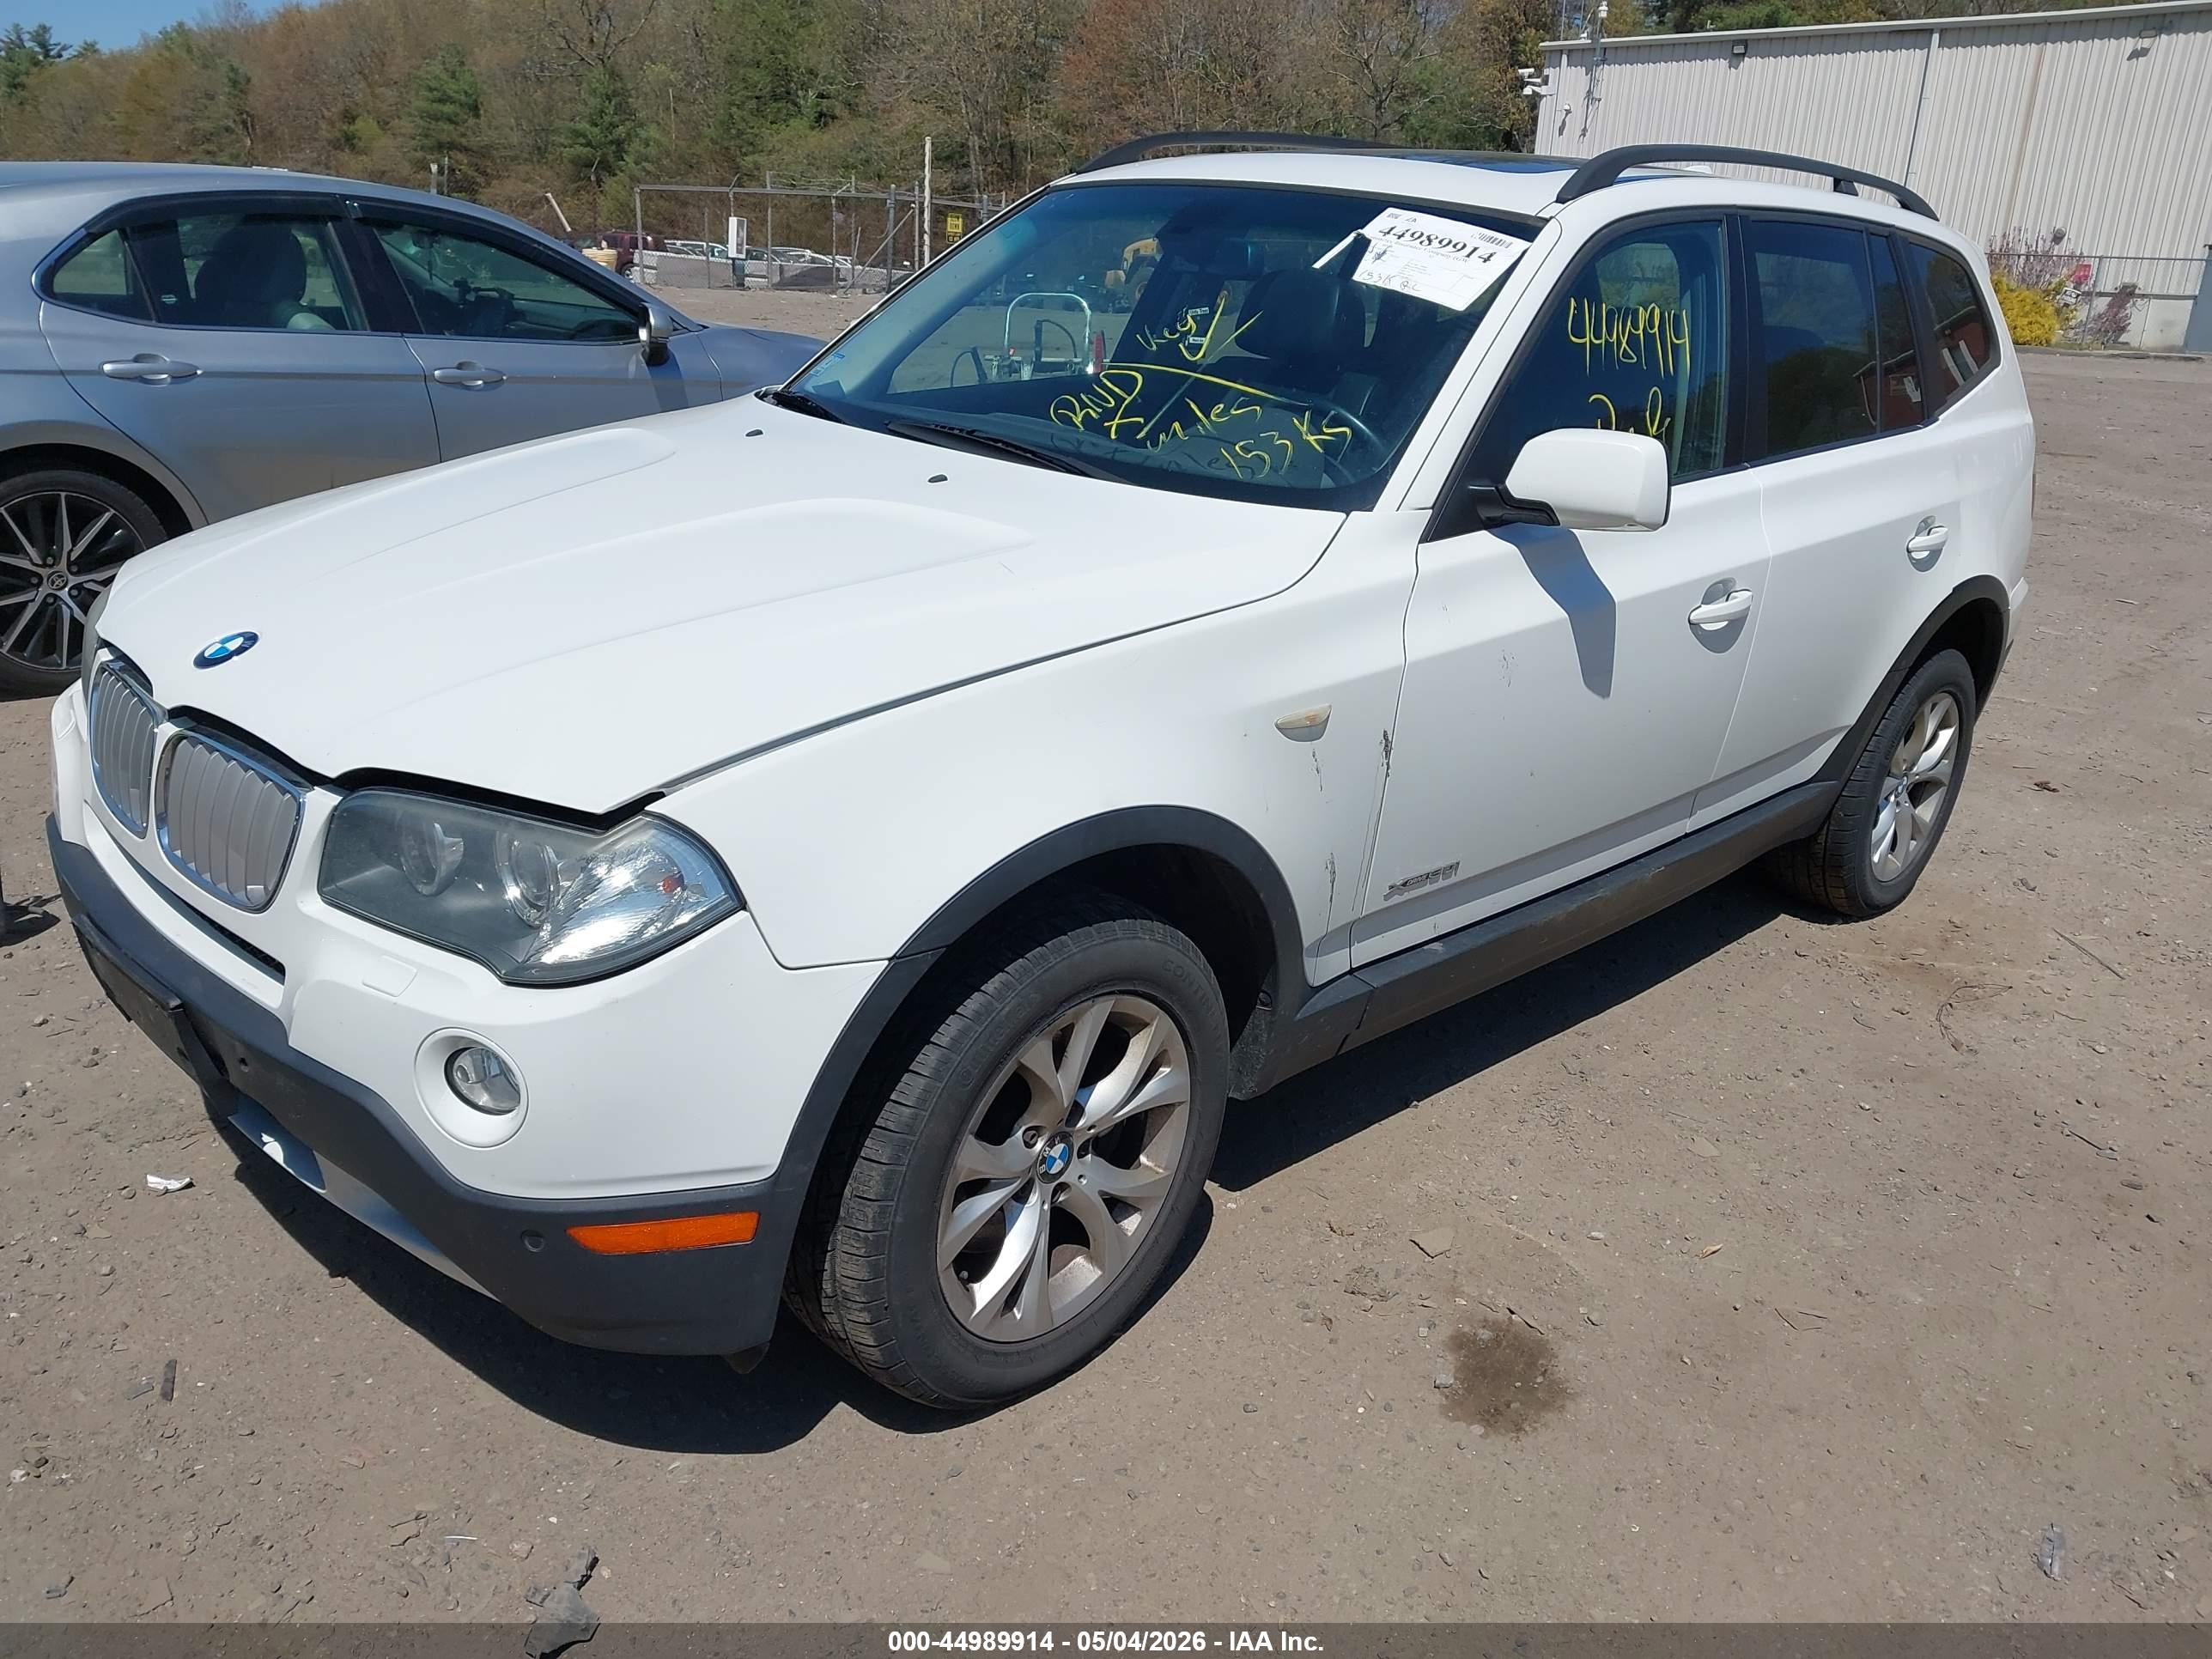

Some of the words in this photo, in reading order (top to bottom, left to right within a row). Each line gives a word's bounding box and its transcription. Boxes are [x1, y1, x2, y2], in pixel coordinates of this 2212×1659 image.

[1378, 225, 1497, 264] 44989914
[1568, 298, 1691, 379] 44989914
[1039, 1134, 1062, 1175] BMW
